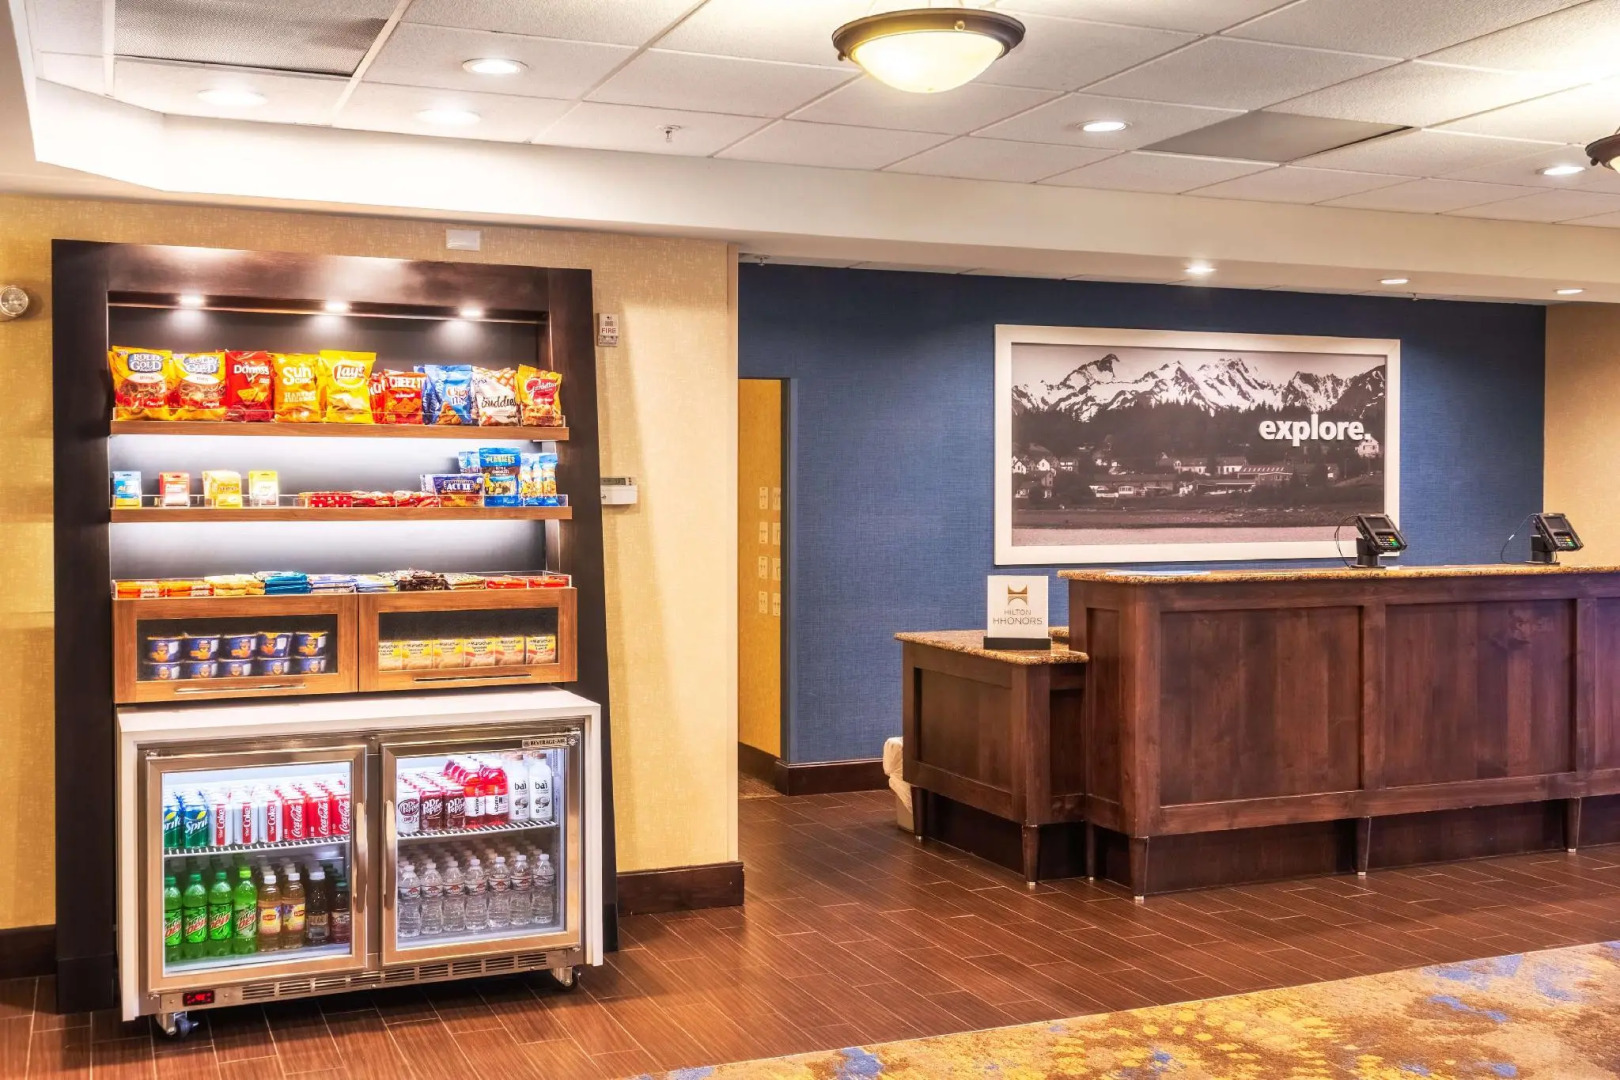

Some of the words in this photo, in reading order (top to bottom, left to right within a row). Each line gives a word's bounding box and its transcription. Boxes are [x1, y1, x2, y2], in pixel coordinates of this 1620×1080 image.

[130, 361, 162, 370] GOLD
[282, 366, 312, 385] Sun
[1258, 413, 1371, 447] explore.
[993, 617, 1043, 625] HHONORS
[514, 780, 527, 790] bai
[534, 780, 548, 790] bai
[216, 809, 225, 829] Coke
[243, 807, 251, 828] Coke
[267, 805, 276, 826] Coke
